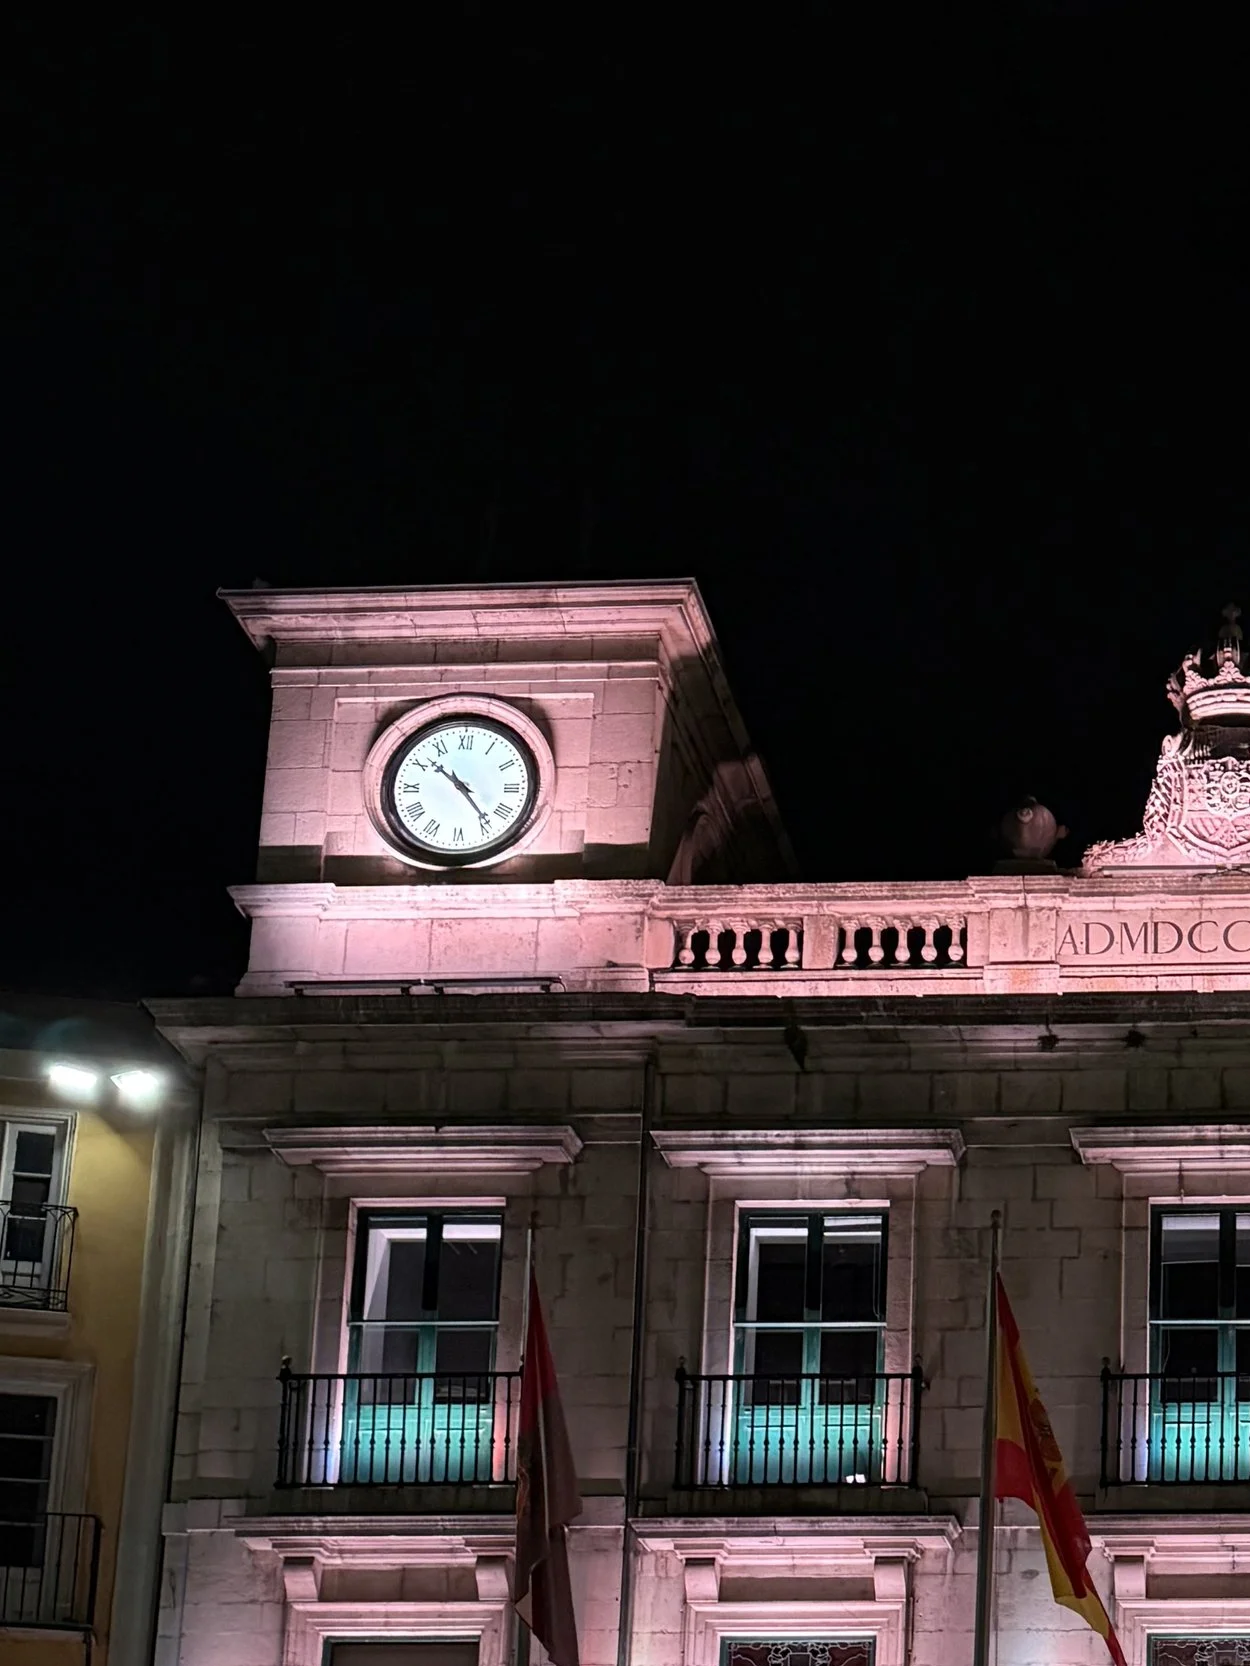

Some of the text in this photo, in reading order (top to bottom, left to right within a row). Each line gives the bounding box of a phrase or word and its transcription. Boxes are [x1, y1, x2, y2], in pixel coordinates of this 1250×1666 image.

[431, 739, 449, 757] XI
[458, 735, 474, 751] XII
[412, 758, 428, 772] X
[498, 759, 515, 771] II
[403, 782, 420, 794] IX
[503, 783, 520, 793] III
[405, 801, 426, 822] VIII
[423, 819, 440, 837] VII
[453, 827, 464, 842] VI
